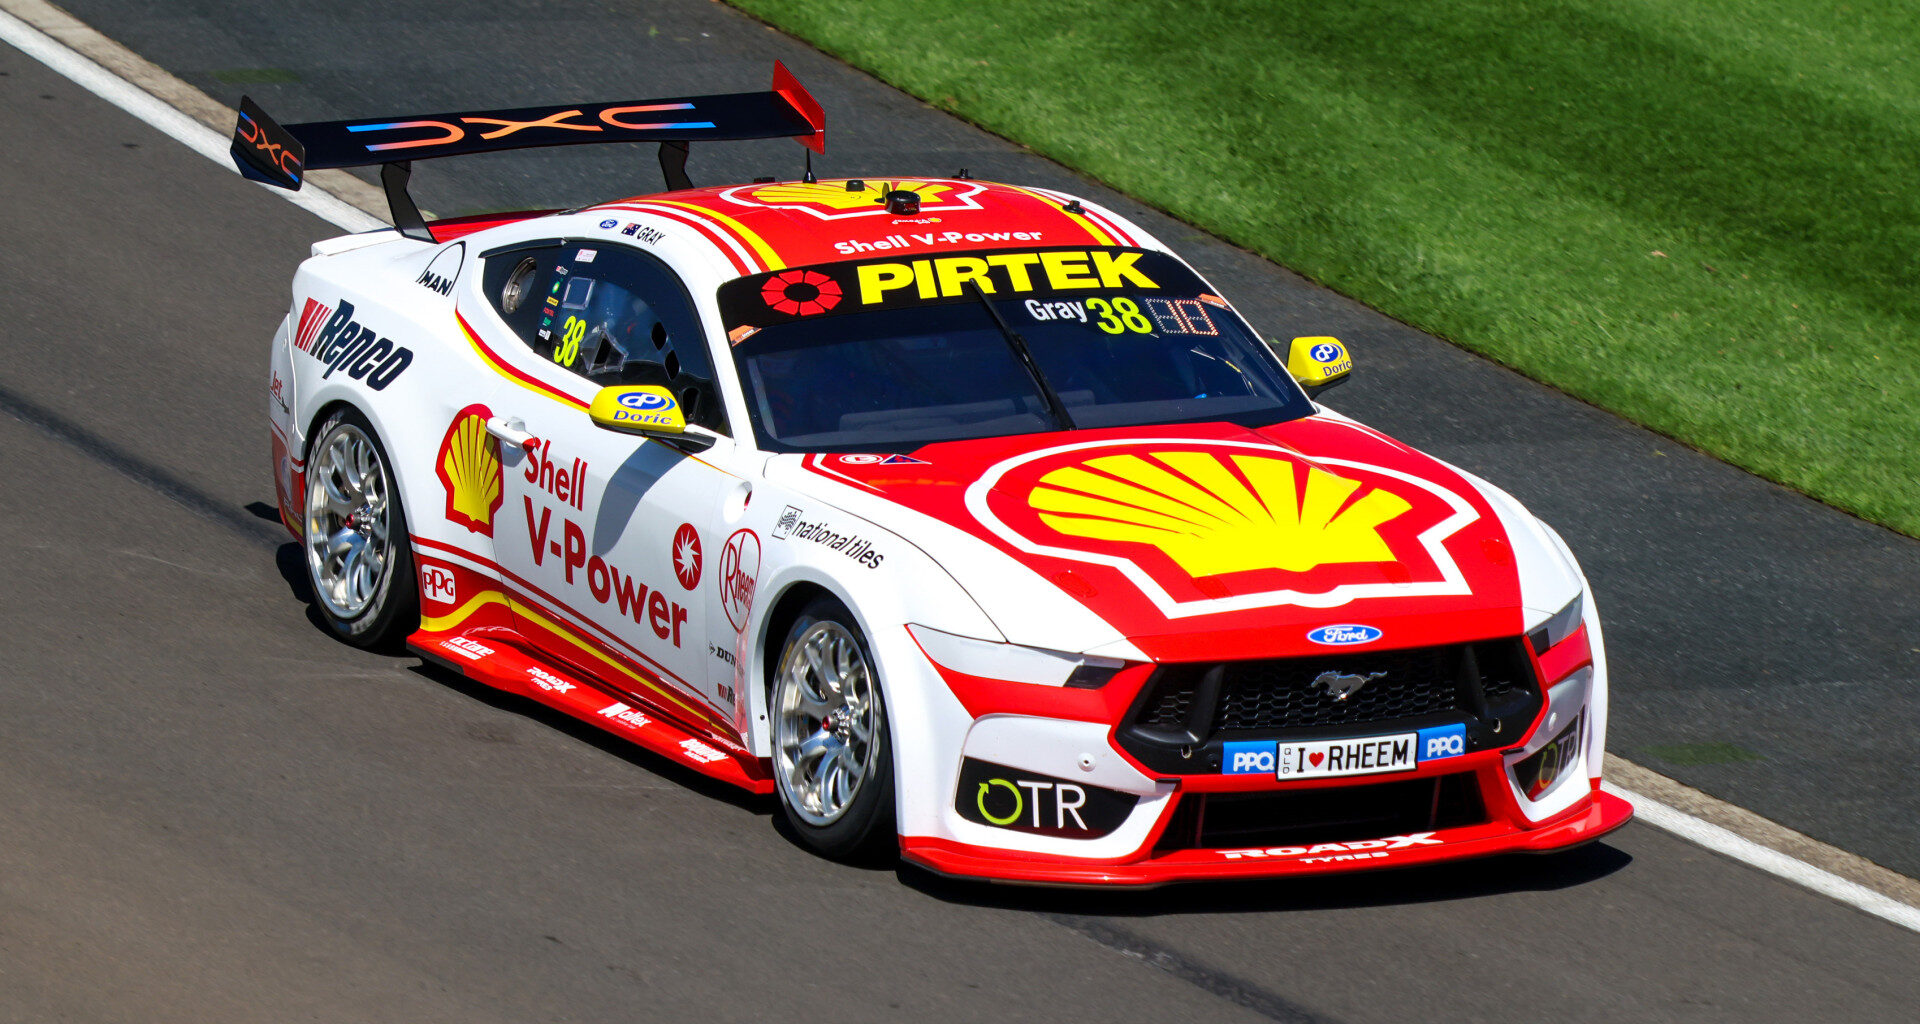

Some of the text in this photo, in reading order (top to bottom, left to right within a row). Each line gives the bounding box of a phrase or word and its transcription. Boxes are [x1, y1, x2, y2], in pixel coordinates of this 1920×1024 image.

[347, 103, 717, 152] DXC
[237, 110, 302, 183] DXC
[637, 226, 666, 246] GRAY
[834, 231, 1043, 255] Shell V-Power
[418, 270, 453, 297] MAN
[856, 251, 1161, 305] PIRTEK
[1024, 296, 1153, 335] Gray 38
[310, 298, 414, 391] Repco
[554, 315, 586, 367] 38
[1322, 360, 1353, 377] Doric
[613, 410, 672, 425] Doric
[524, 438, 588, 512] Shell
[422, 568, 454, 598] PPG
[523, 494, 688, 649] V-Power
[1323, 626, 1369, 643] Ford
[1327, 739, 1409, 771] RHEEM
[1428, 734, 1464, 758] PPQ
[1233, 751, 1275, 772] PPQ
[977, 778, 1088, 831] OTR
[1215, 831, 1444, 859] ROADX
[1298, 851, 1390, 864] TYRES
